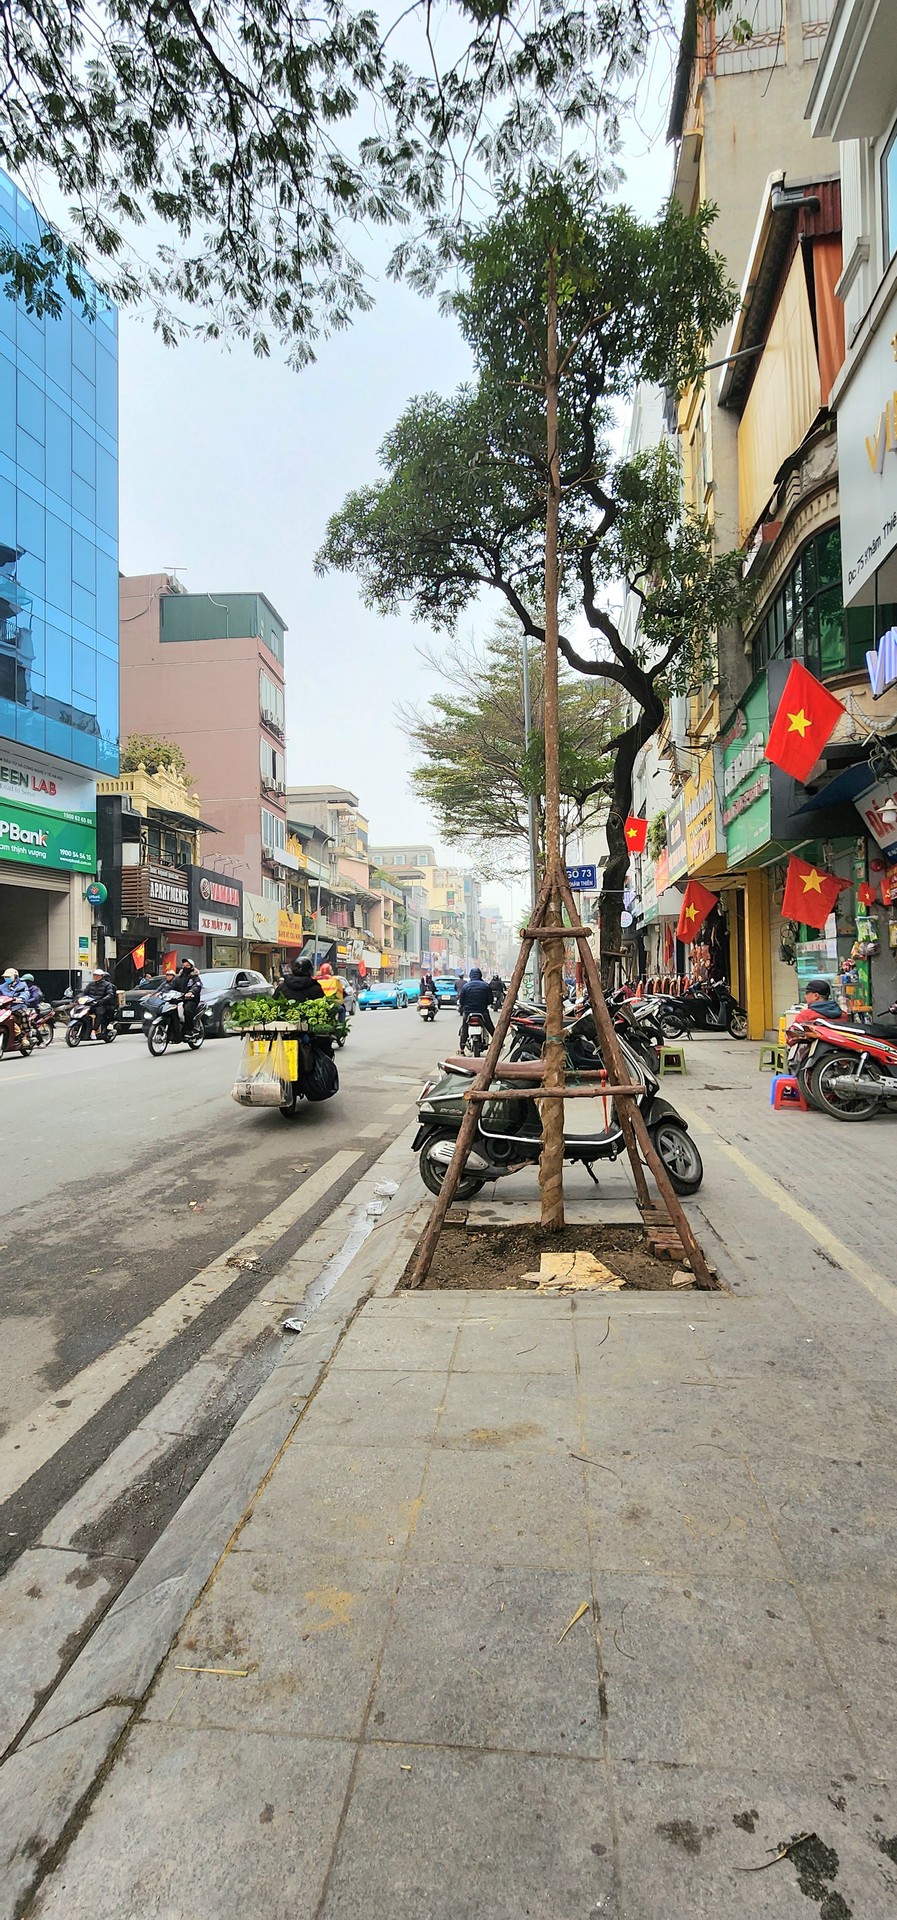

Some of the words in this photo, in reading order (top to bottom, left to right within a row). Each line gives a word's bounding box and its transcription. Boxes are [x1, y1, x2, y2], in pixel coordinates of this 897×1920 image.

[31, 775, 57, 796] LAB
[11, 845, 27, 854] thịnh
[28, 849, 46, 859] vượng
[581, 869, 592, 878] 73
[150, 881, 188, 905] APARTMENTS
[210, 881, 240, 907] YAMAHA
[202, 918, 210, 928] XE
[211, 918, 223, 930] MÁY
